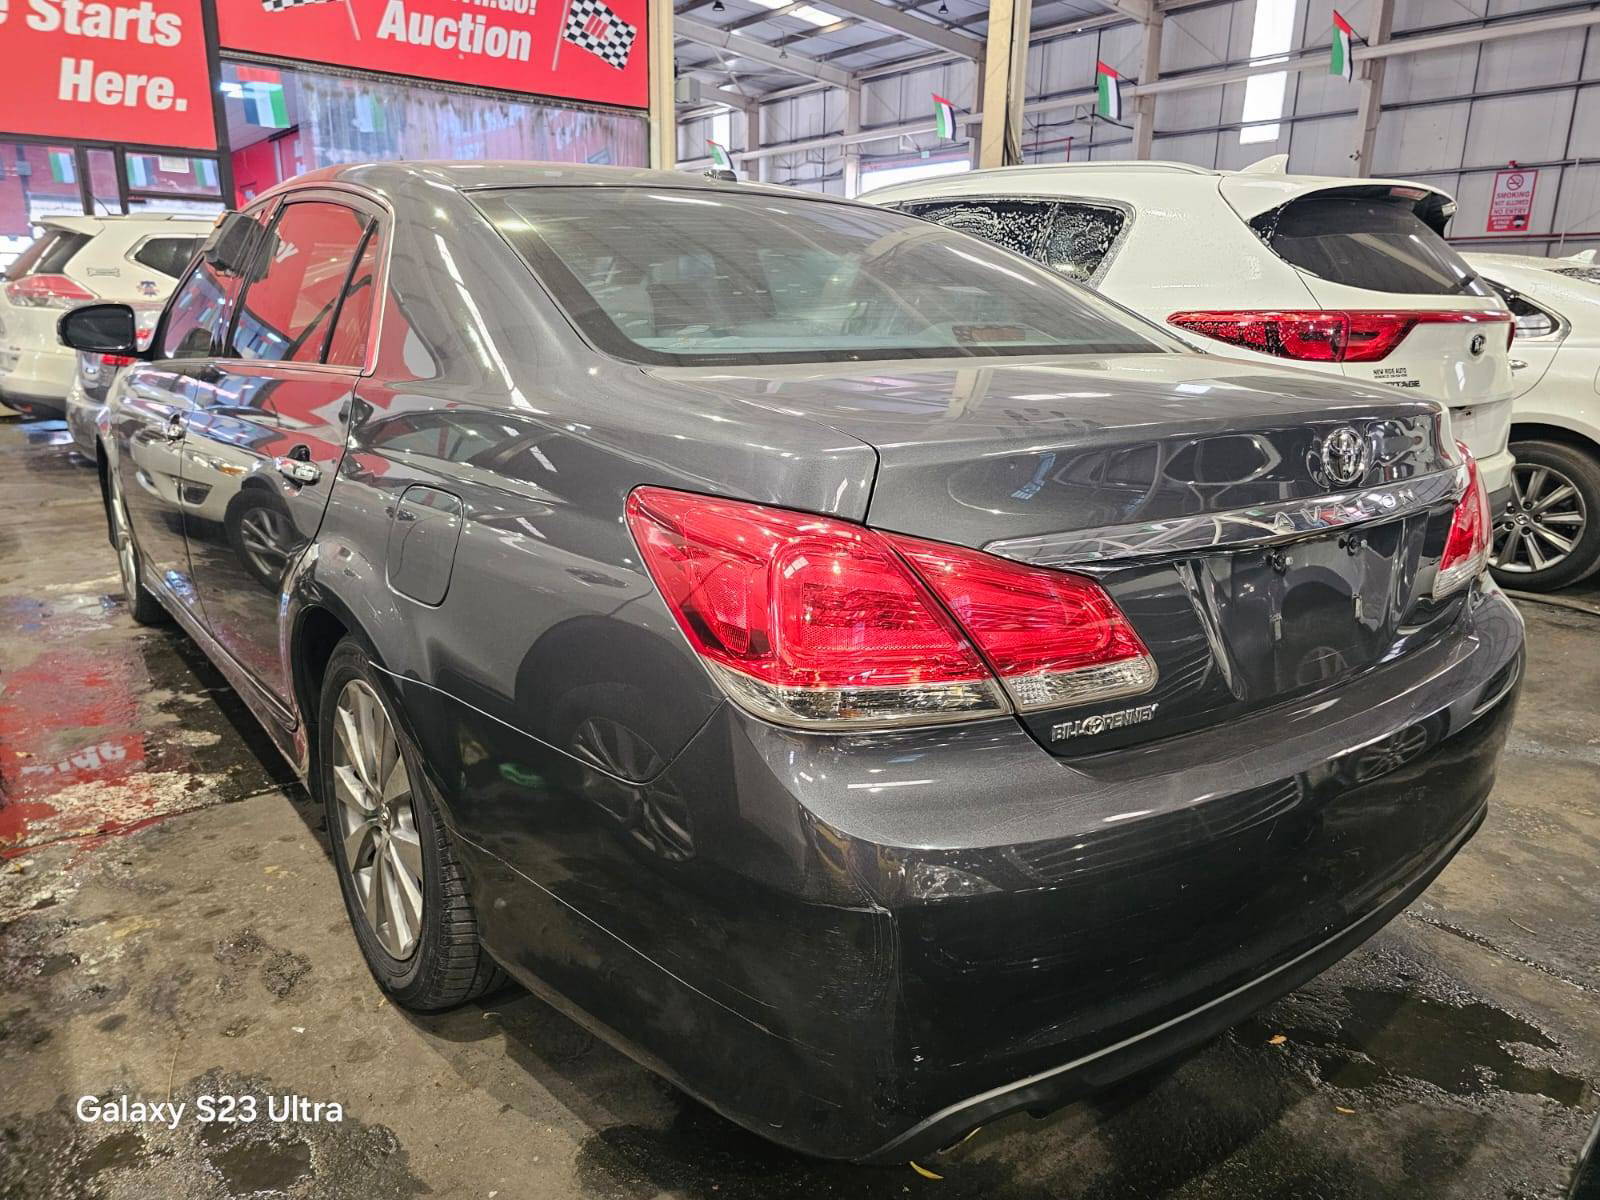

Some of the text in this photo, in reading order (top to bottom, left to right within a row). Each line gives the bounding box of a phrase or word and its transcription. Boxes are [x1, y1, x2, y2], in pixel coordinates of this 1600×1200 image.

[26, 0, 182, 47] Starts
[376, 0, 532, 62] Auction
[58, 57, 188, 112] Here.
[1496, 191, 1530, 199] SMOKING
[1273, 488, 1421, 531] AVALON
